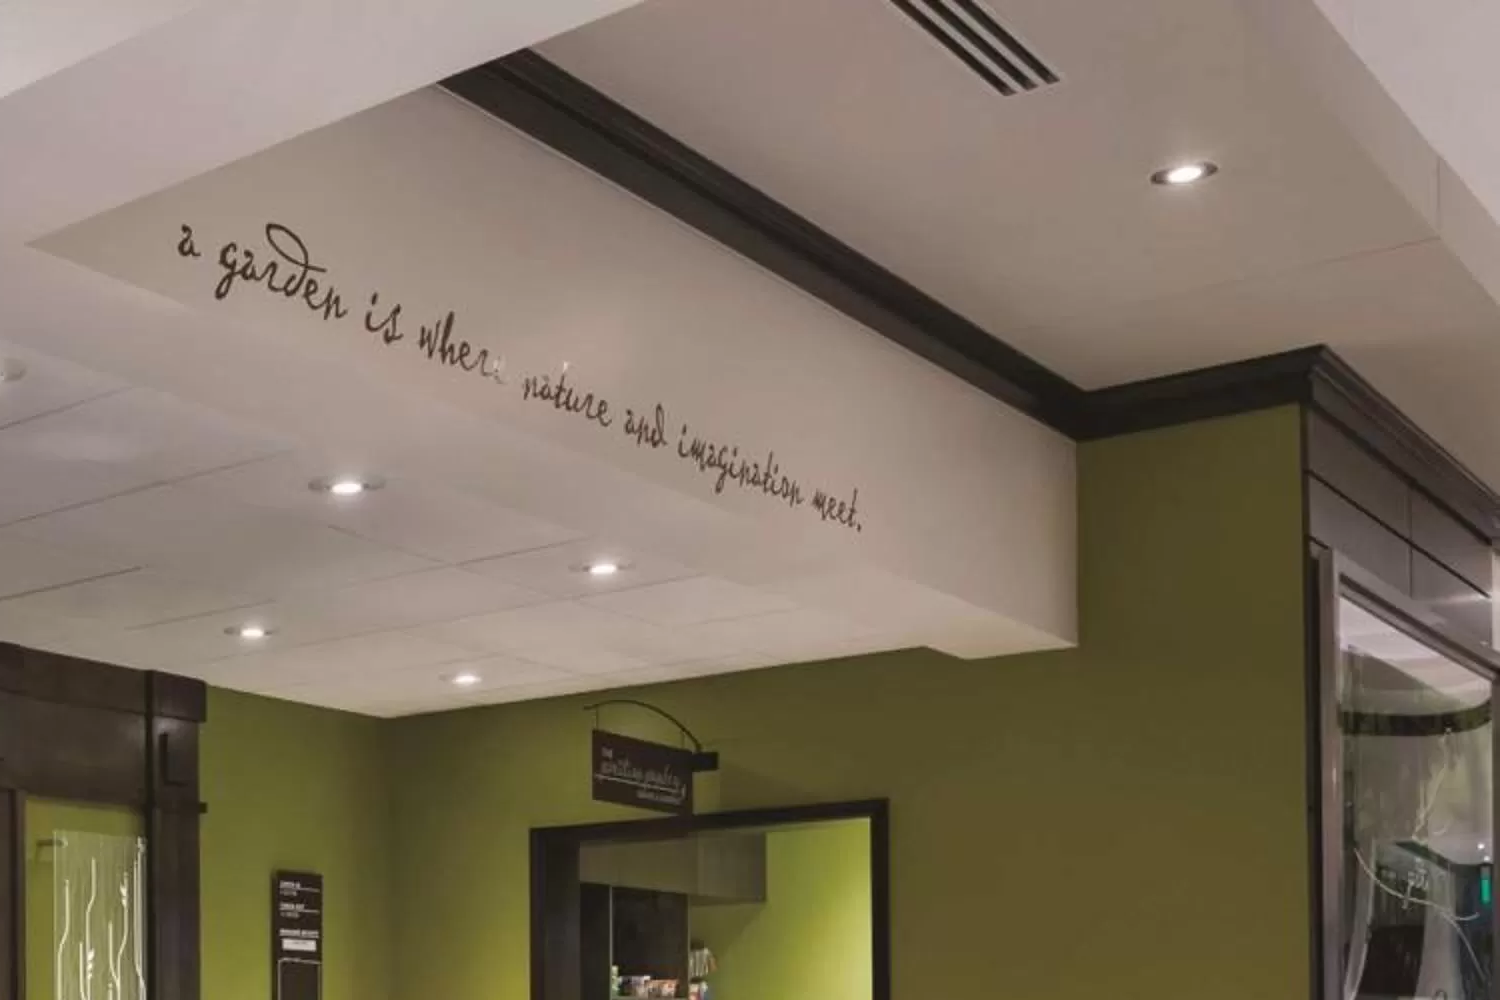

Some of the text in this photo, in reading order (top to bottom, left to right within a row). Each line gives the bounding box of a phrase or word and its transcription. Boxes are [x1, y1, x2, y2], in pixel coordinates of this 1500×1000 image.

[177, 224, 201, 258] a
[214, 222, 348, 321] garden
[364, 292, 405, 346] is
[522, 372, 613, 428] nature
[623, 402, 669, 449] and
[677, 424, 805, 507] imagination
[811, 487, 863, 533] meet.
